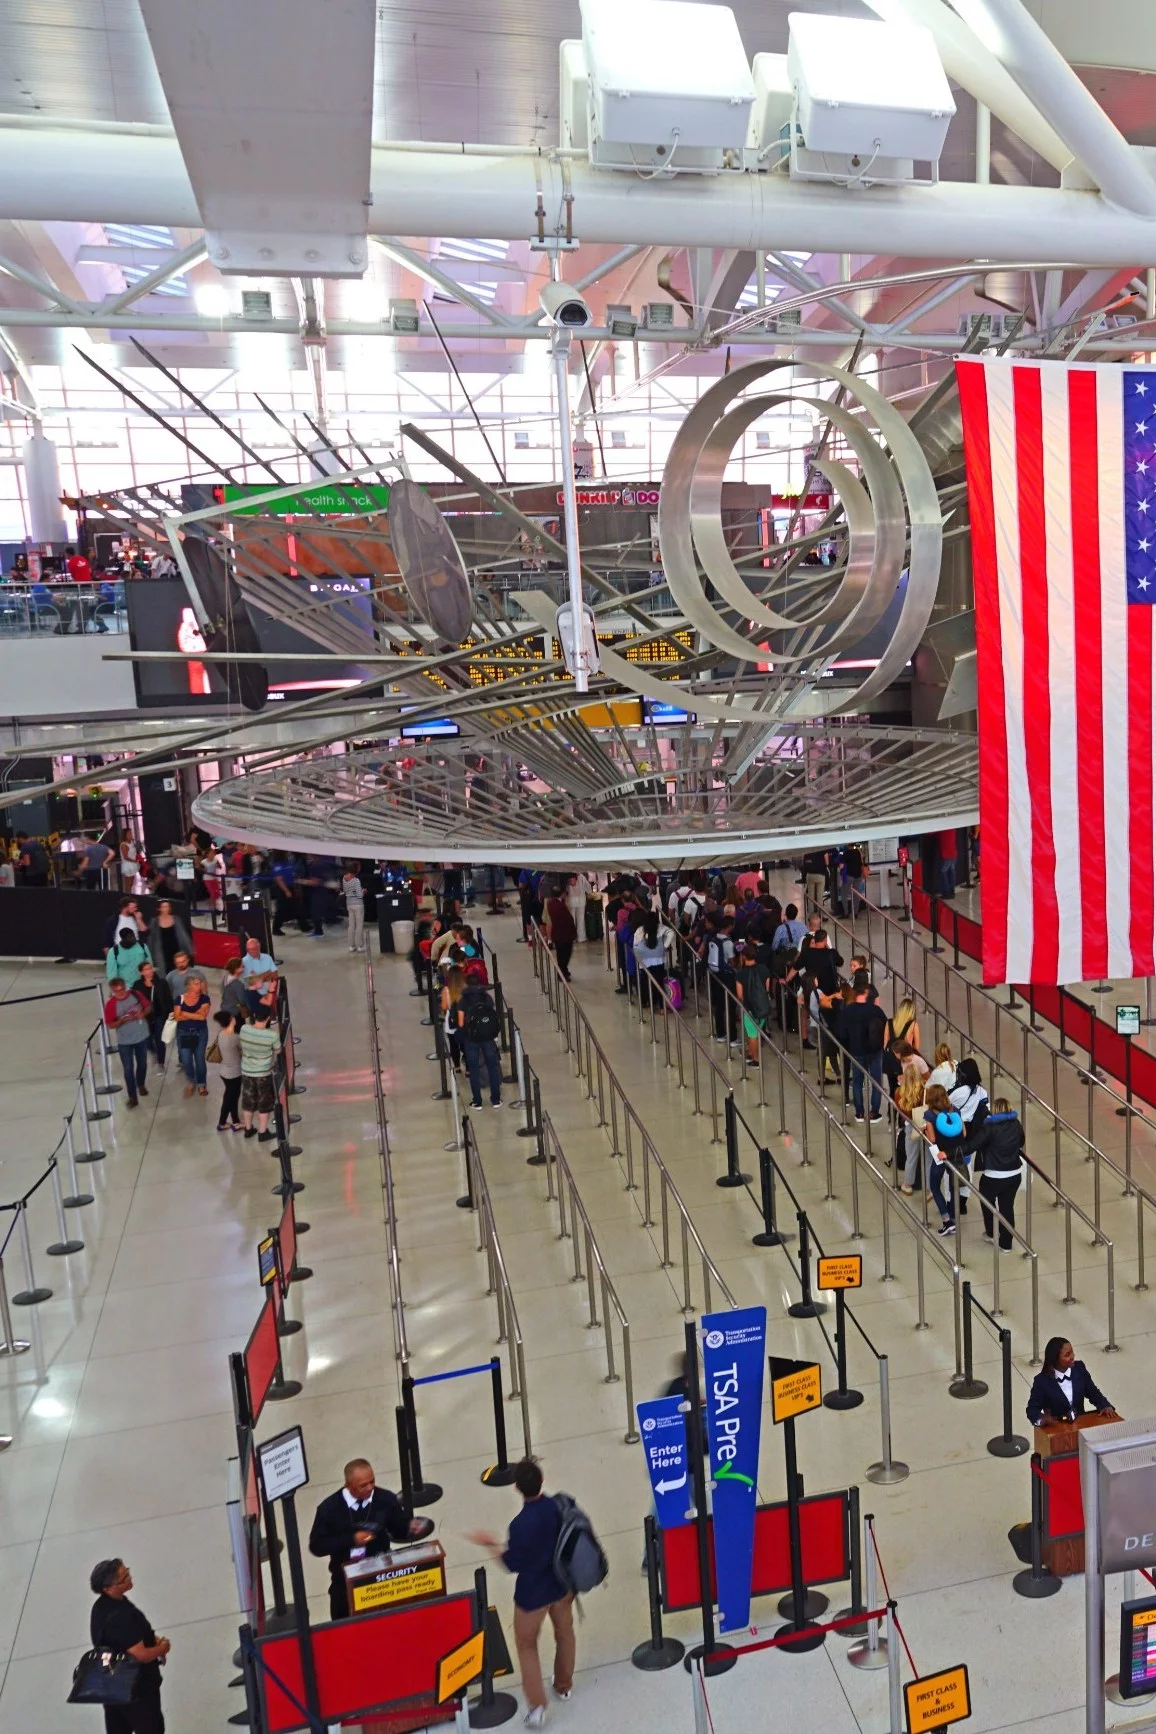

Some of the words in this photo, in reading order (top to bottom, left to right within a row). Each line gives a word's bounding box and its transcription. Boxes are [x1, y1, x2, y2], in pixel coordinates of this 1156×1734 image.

[724, 1325, 761, 1336] Transportation
[725, 1333, 747, 1341] Security
[725, 1335, 763, 1346] Administration
[713, 1362, 739, 1415] TSA
[777, 1386, 801, 1399] BUSINESS
[801, 1380, 817, 1390] CLASS
[782, 1381, 796, 1389] FIRST
[796, 1375, 812, 1384] CLASS
[656, 1414, 683, 1422] Transportation
[715, 1417, 740, 1461] Pre
[263, 1444, 299, 1466] Passengers
[649, 1443, 684, 1459] Enter
[274, 1457, 291, 1471] Enter
[652, 1456, 682, 1470] Here
[276, 1466, 291, 1478] Here
[375, 1565, 418, 1582] SECURITY
[360, 1588, 395, 1602] boarding
[396, 1585, 413, 1594] pass
[414, 1578, 436, 1588] ready
[366, 1582, 390, 1594] Please
[391, 1578, 410, 1587] have
[411, 1573, 429, 1583] your
[446, 1654, 476, 1680] ECONOMY
[916, 1689, 935, 1703] FIRST
[935, 1682, 958, 1696] CLASS
[922, 1702, 955, 1719] BUSINESS
